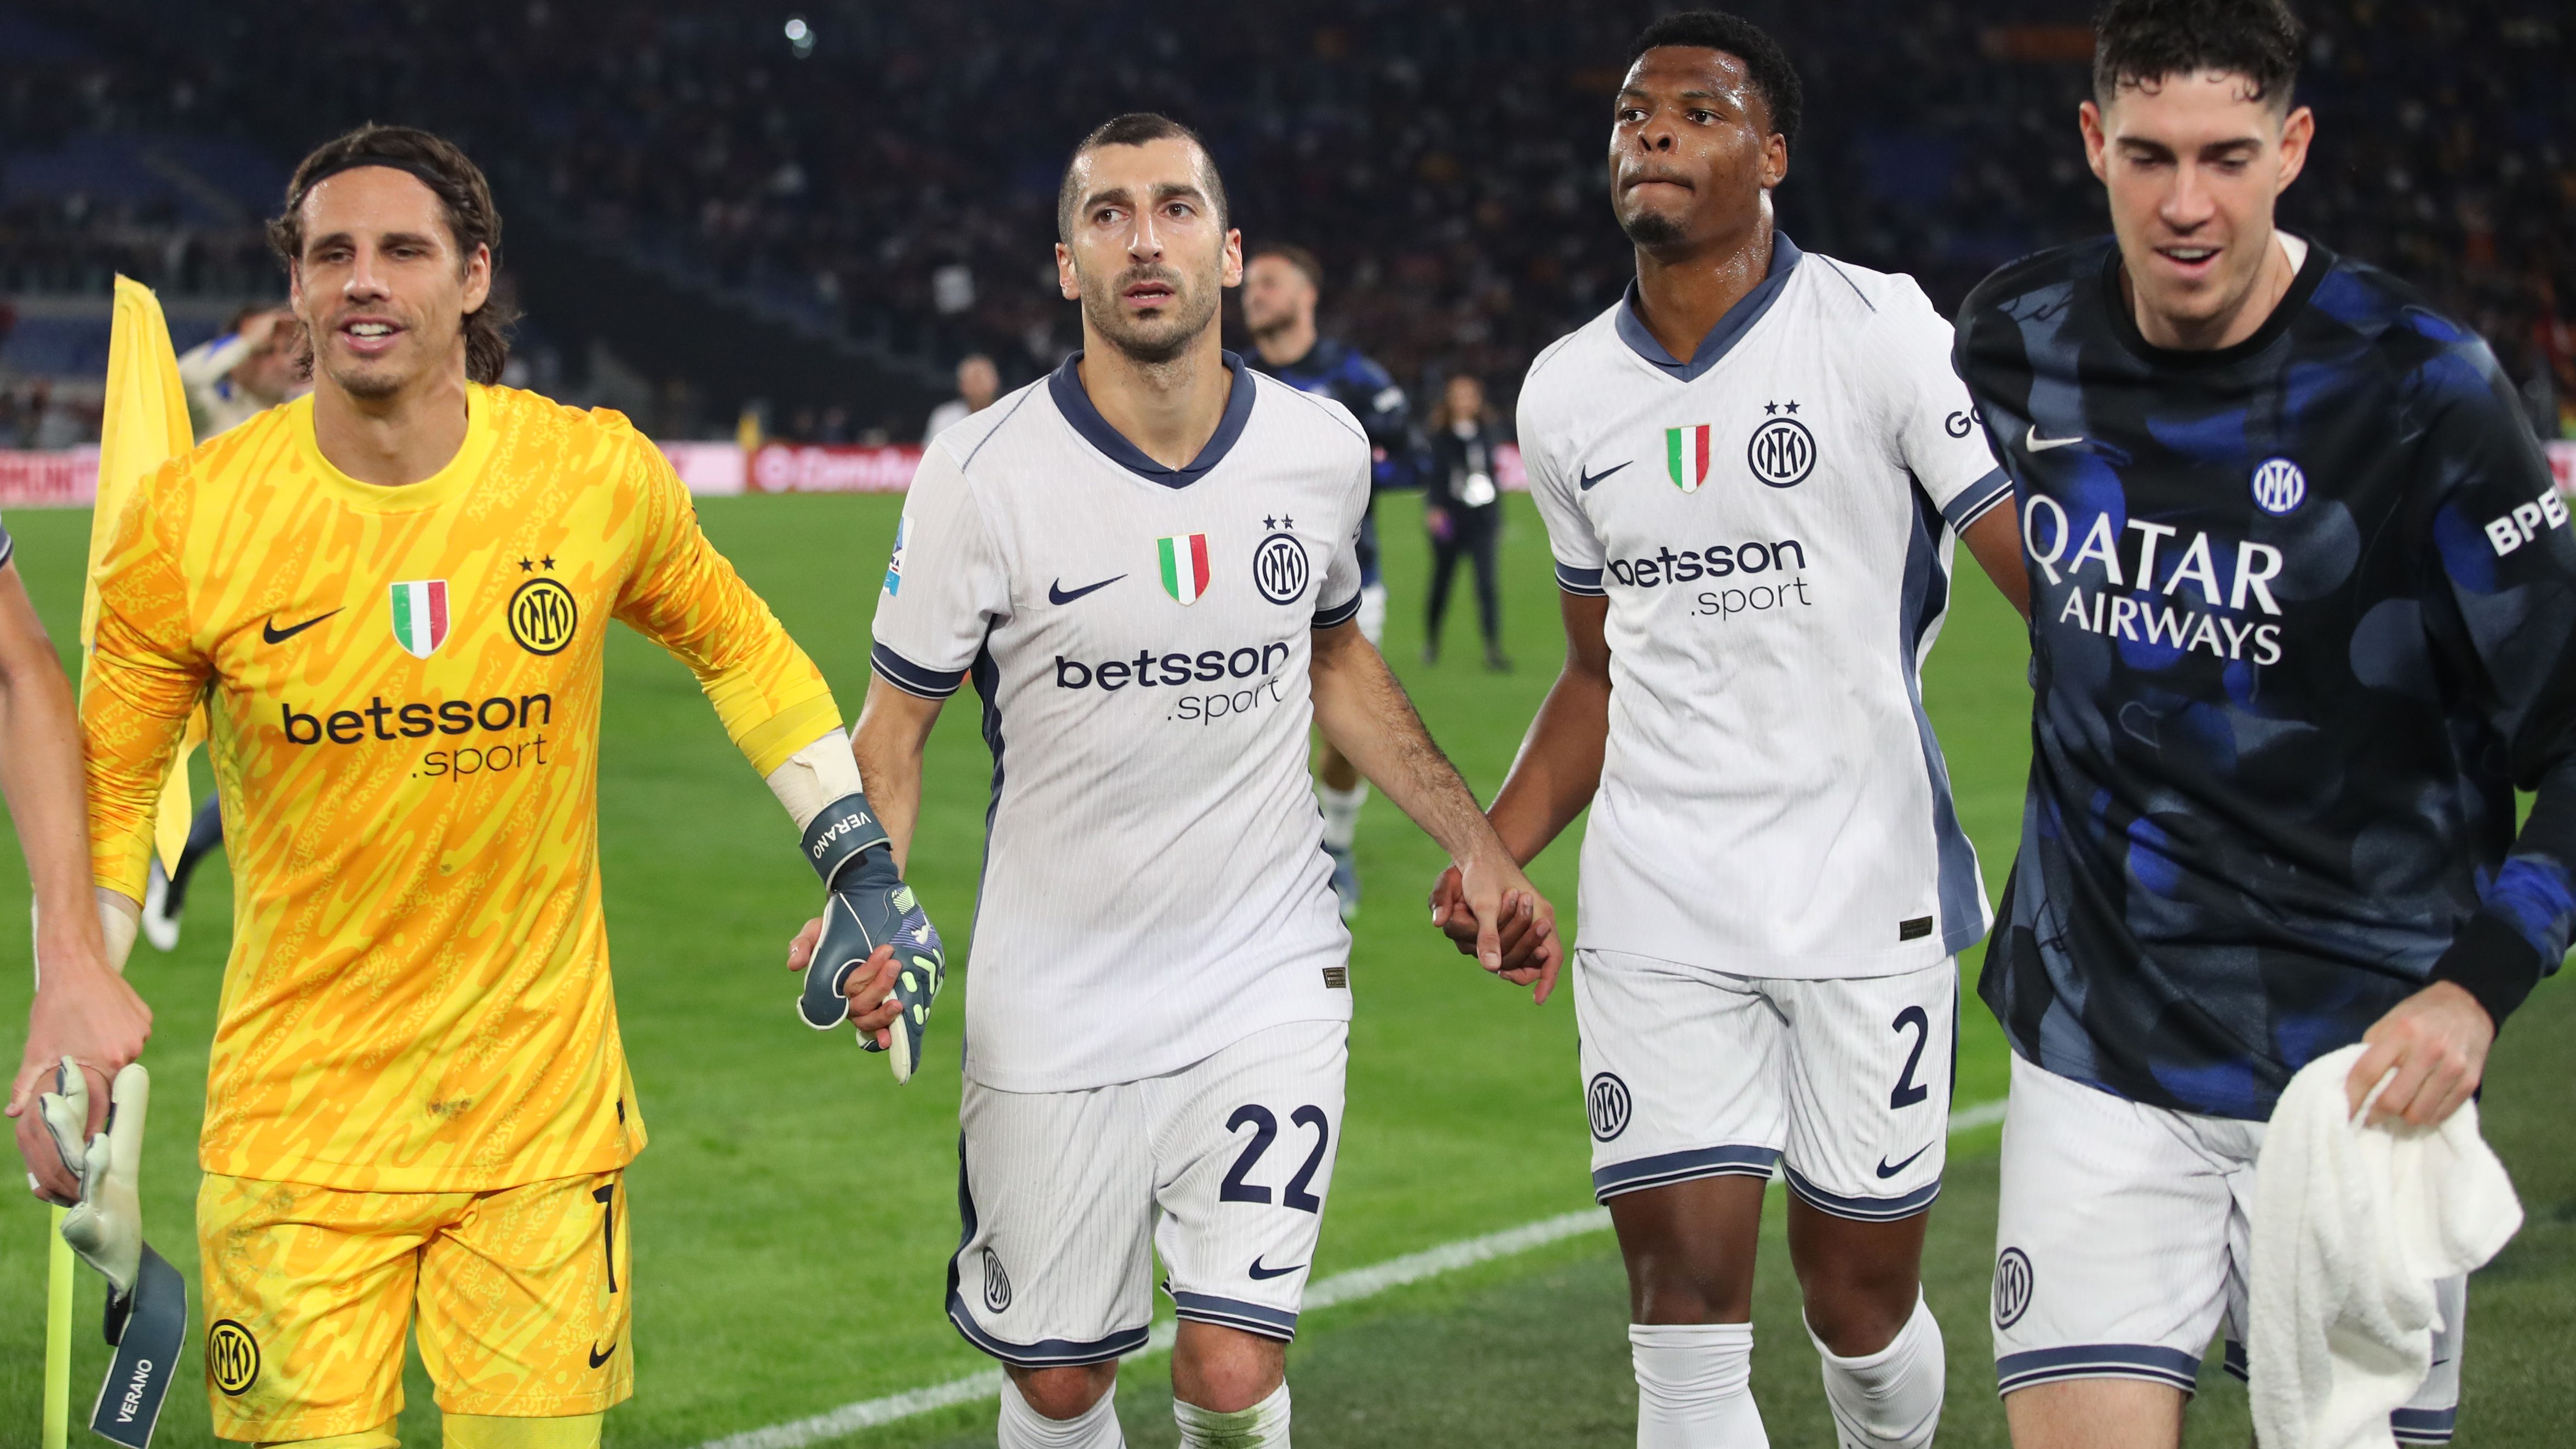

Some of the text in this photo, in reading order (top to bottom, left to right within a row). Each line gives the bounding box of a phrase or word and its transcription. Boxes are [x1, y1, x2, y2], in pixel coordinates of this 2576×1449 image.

[2485, 485, 2569, 557] BPE
[1606, 540, 1807, 588] betsson
[2024, 494, 2284, 617] QATAR
[1691, 577, 1812, 621] .sport
[2059, 586, 2282, 666] AIRWAYS
[1055, 641, 1290, 692] betsson
[281, 693, 551, 745] betsson
[1167, 676, 1281, 726] .sport
[411, 733, 548, 783] .sport
[813, 810, 872, 860] VERANO
[1890, 1005, 1929, 1110] 2
[1219, 1103, 1329, 1215] 22
[591, 1183, 618, 1294] 1
[116, 1359, 153, 1423] VERANO
